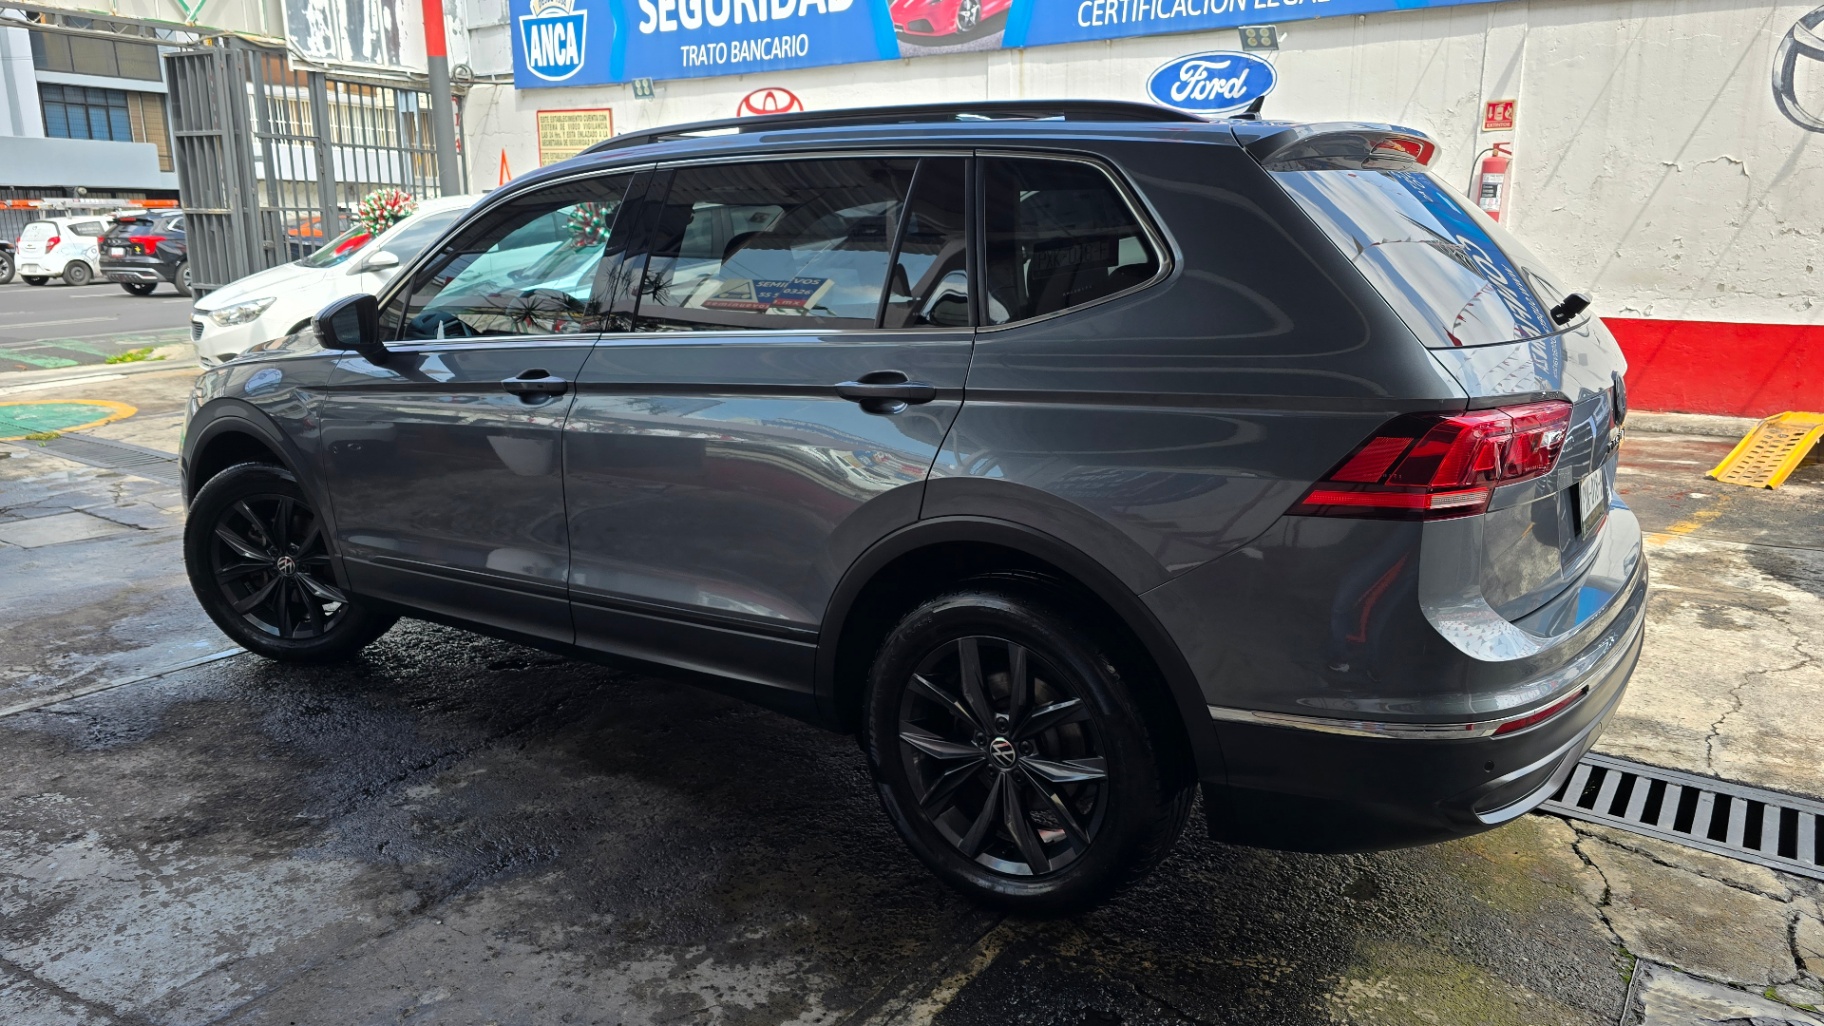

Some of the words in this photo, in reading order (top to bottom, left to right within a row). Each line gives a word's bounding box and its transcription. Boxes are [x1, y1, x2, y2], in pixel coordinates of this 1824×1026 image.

[639, 0, 853, 34] SEGURID
[531, 22, 579, 67] ANCA
[680, 42, 728, 67] TRATO
[730, 33, 809, 63] BANCARIO
[1170, 60, 1250, 102] Ford
